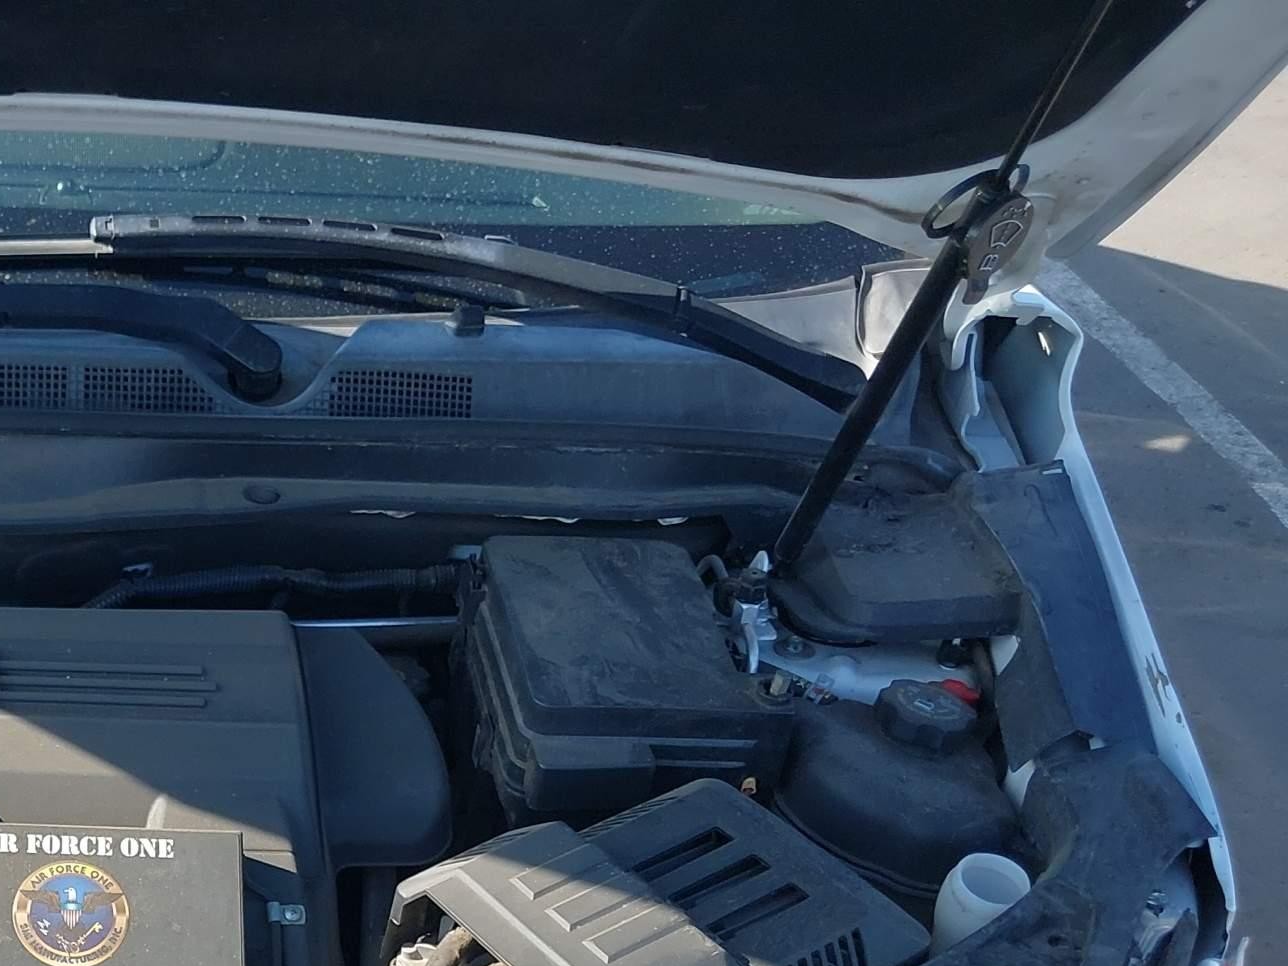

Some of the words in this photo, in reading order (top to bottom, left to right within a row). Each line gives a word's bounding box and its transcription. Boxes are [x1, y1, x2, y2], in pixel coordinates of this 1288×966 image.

[25, 833, 113, 857] FORCE
[119, 837, 176, 859] ONE
[30, 872, 49, 888] AIR
[49, 864, 86, 875] FORCE
[90, 870, 114, 890] ONE
